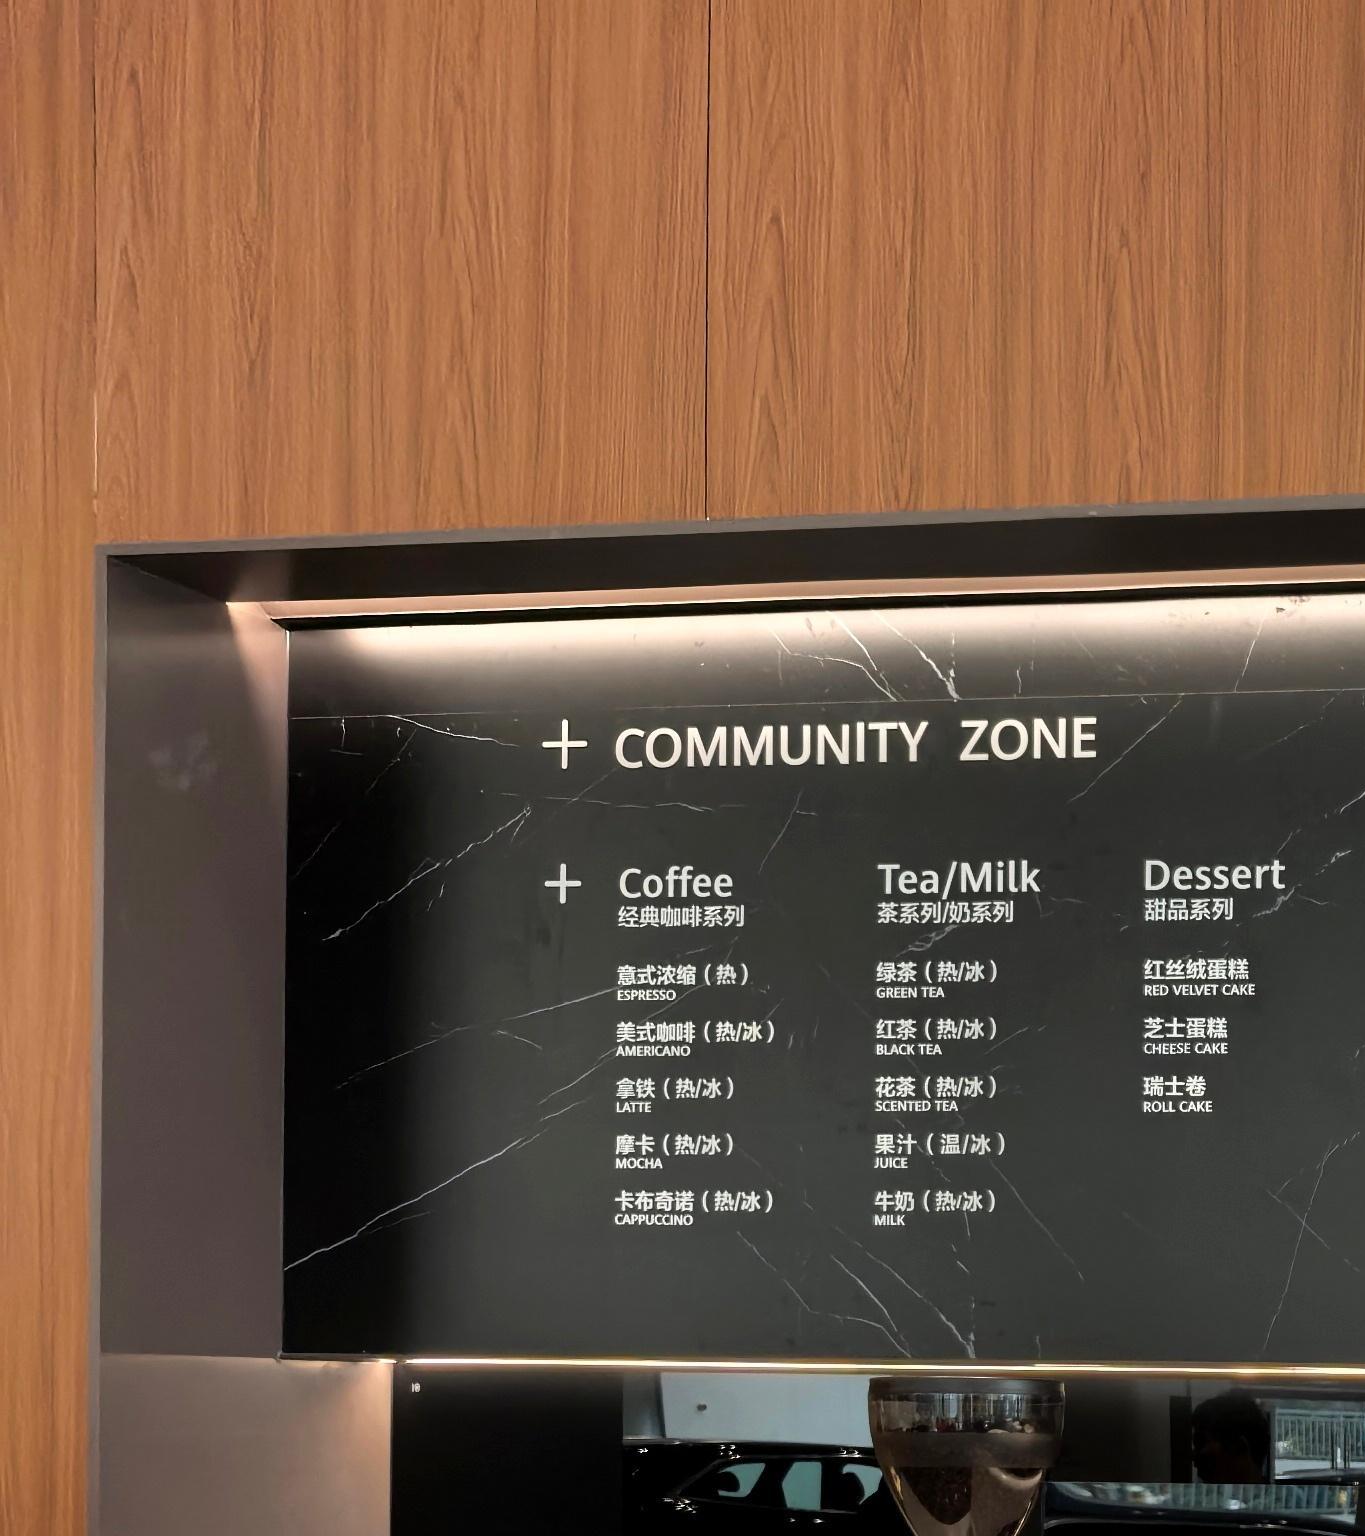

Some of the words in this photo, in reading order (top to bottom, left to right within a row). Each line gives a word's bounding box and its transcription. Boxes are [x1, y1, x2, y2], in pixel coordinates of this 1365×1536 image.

[615, 721, 929, 768] COMMUNITY
[960, 716, 1097, 761] ZONE
[877, 860, 1040, 900] Tea/Milk
[1145, 860, 1285, 890] Dessert
[620, 867, 733, 898] Coffee
[877, 899, 1013, 924] 茶系列/奶系列
[1145, 898, 1233, 921] 甜品系列
[618, 905, 744, 927] 经典咖啡系列
[1144, 958, 1249, 980] 红丝绒蛋糕
[617, 988, 676, 1000] ESPRESSO
[877, 986, 917, 998] GREEN
[921, 986, 944, 997] TEA
[1145, 985, 1169, 996] RED
[1172, 984, 1218, 996] VELVET
[1221, 984, 1255, 995] CAKE
[1144, 1017, 1227, 1038] 芝士蛋糕
[615, 1045, 690, 1056] AMERICANO
[876, 1044, 915, 1055] BLACK
[918, 1044, 942, 1055] TEA
[1144, 1043, 1191, 1054] CHEESE
[1195, 1043, 1228, 1054] CAKE
[1143, 1076, 1206, 1096] 瑞士卷
[616, 1101, 651, 1112] LATTE
[875, 1100, 931, 1111] SCENTED
[935, 1100, 958, 1111] TEA
[1143, 1101, 1176, 1112] ROLL
[1179, 1101, 1212, 1112] CAKE
[615, 1157, 663, 1169] MOCHA
[874, 1157, 908, 1168] JUICE
[615, 1214, 693, 1225] CAPPUCCINO
[875, 1214, 905, 1225] MILK
